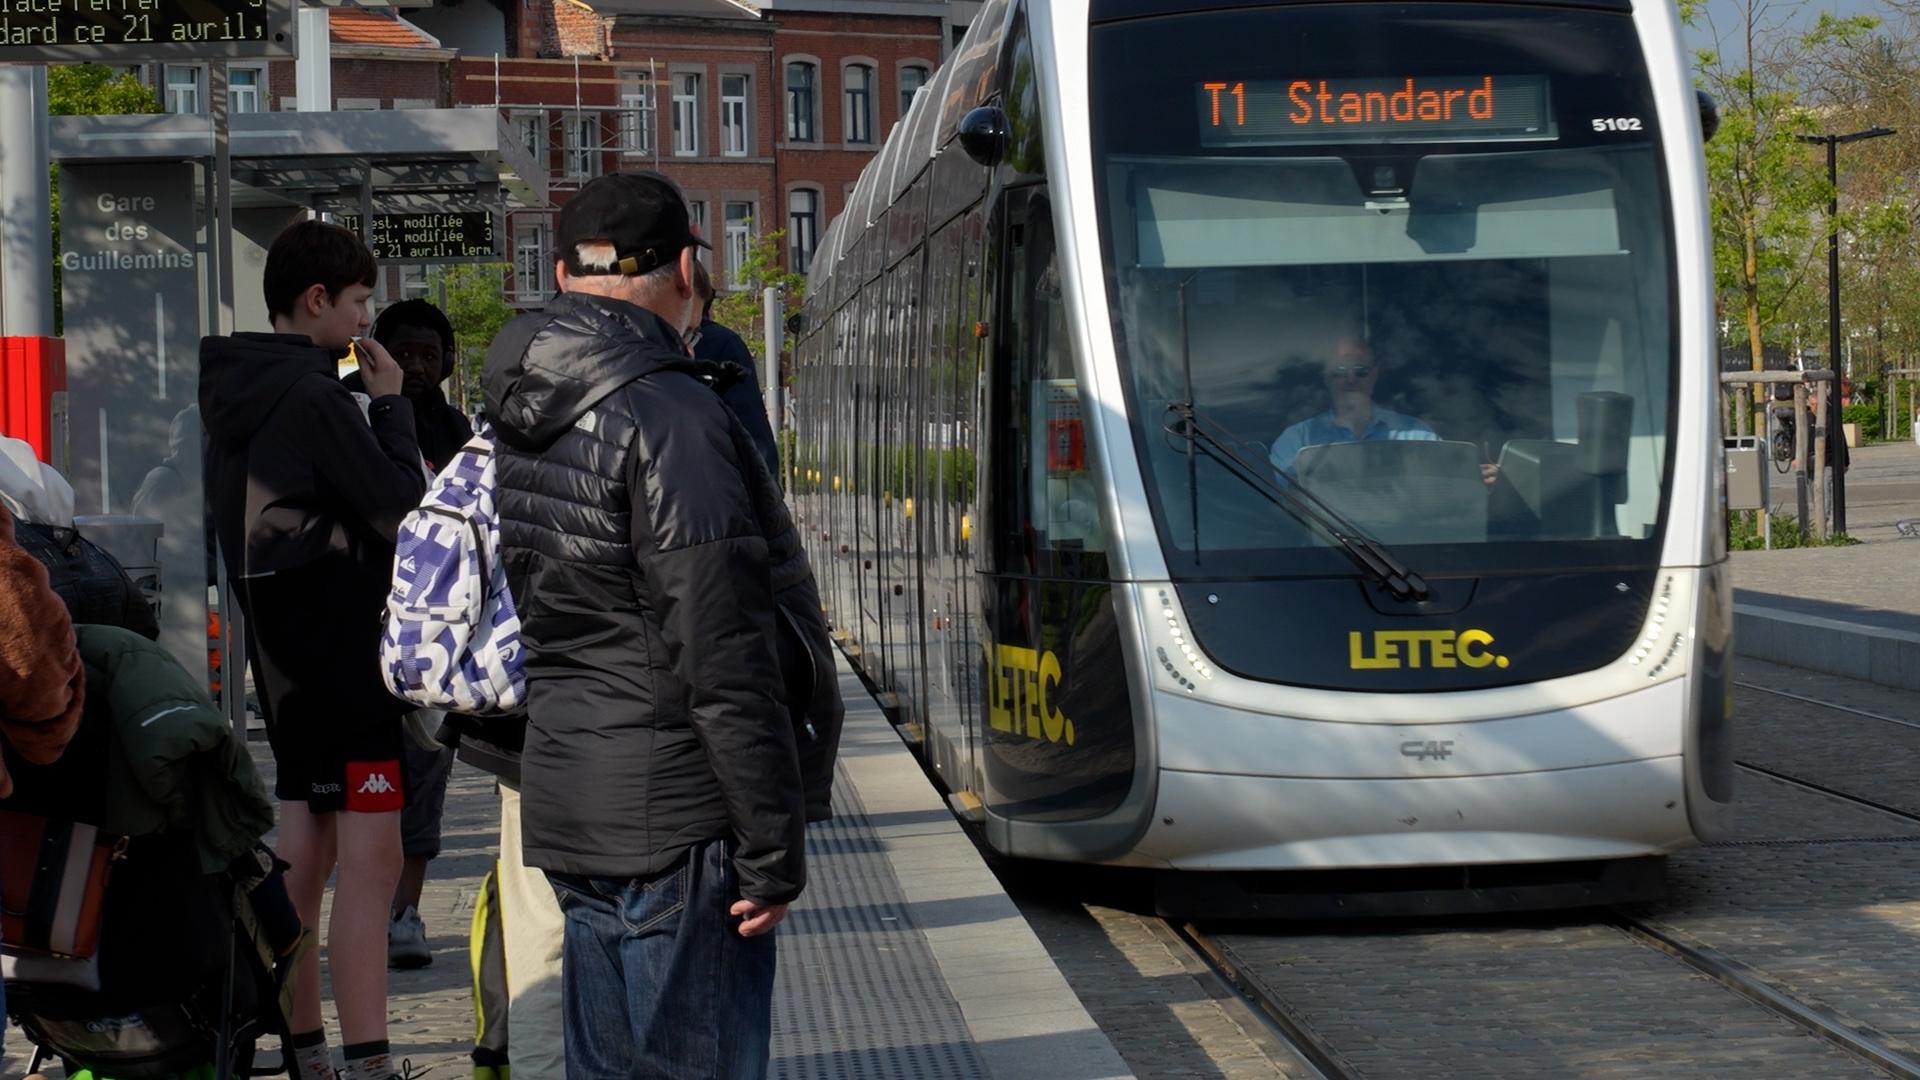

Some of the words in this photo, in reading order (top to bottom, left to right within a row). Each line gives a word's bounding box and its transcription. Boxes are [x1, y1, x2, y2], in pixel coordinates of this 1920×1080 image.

[75, 25, 105, 43] ce
[122, 14, 154, 42] 21
[172, 12, 262, 40] avril,
[1204, 82, 1246, 126] T1
[1288, 76, 1494, 125] Standard
[1592, 118, 1643, 132] 5102
[97, 193, 156, 213] Gare
[105, 221, 149, 241] des
[404, 214, 463, 229] modifiée
[404, 228, 464, 243] modifiée
[484, 227, 492, 241] 3
[62, 249, 194, 271] Guillemins
[387, 243, 402, 258] 21
[409, 242, 453, 257] avril,
[1349, 628, 1510, 670] LETEC.
[988, 644, 1075, 746] LETEC.
[1400, 741, 1455, 761] CAF
